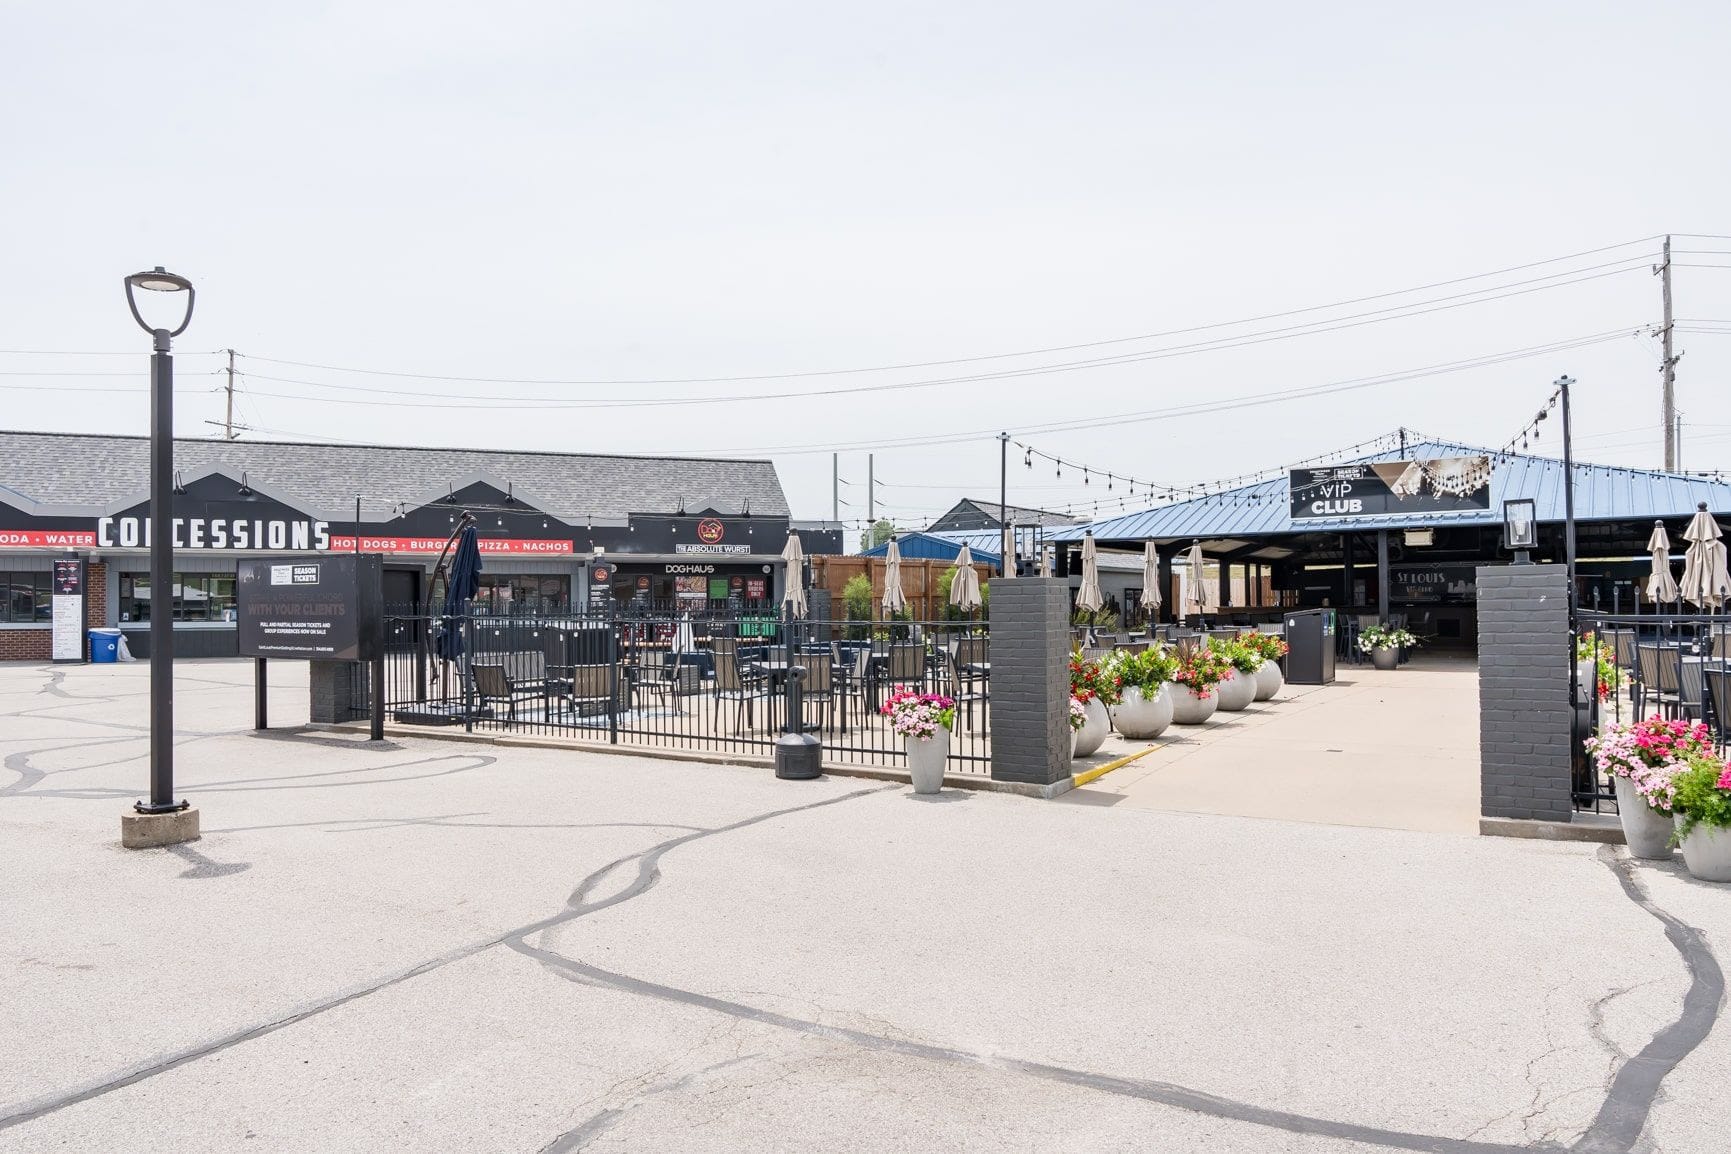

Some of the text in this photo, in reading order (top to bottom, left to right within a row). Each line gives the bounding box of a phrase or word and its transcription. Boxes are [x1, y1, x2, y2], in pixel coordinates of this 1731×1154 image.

[1321, 484, 1352, 498] VIP
[1311, 499, 1362, 514] CLUB
[0, 535, 93, 544] ODA WATER
[334, 540, 569, 551] HOT DOGS BURGER PIZZA NACHOS
[687, 545, 722, 553] ABSOLUTE
[724, 545, 748, 553] WURST
[294, 567, 316, 575] SEASON
[294, 574, 316, 582] TICKETS
[1411, 573, 1445, 584] LOUIS
[248, 603, 345, 616] WITH YOUR CLIENTS
